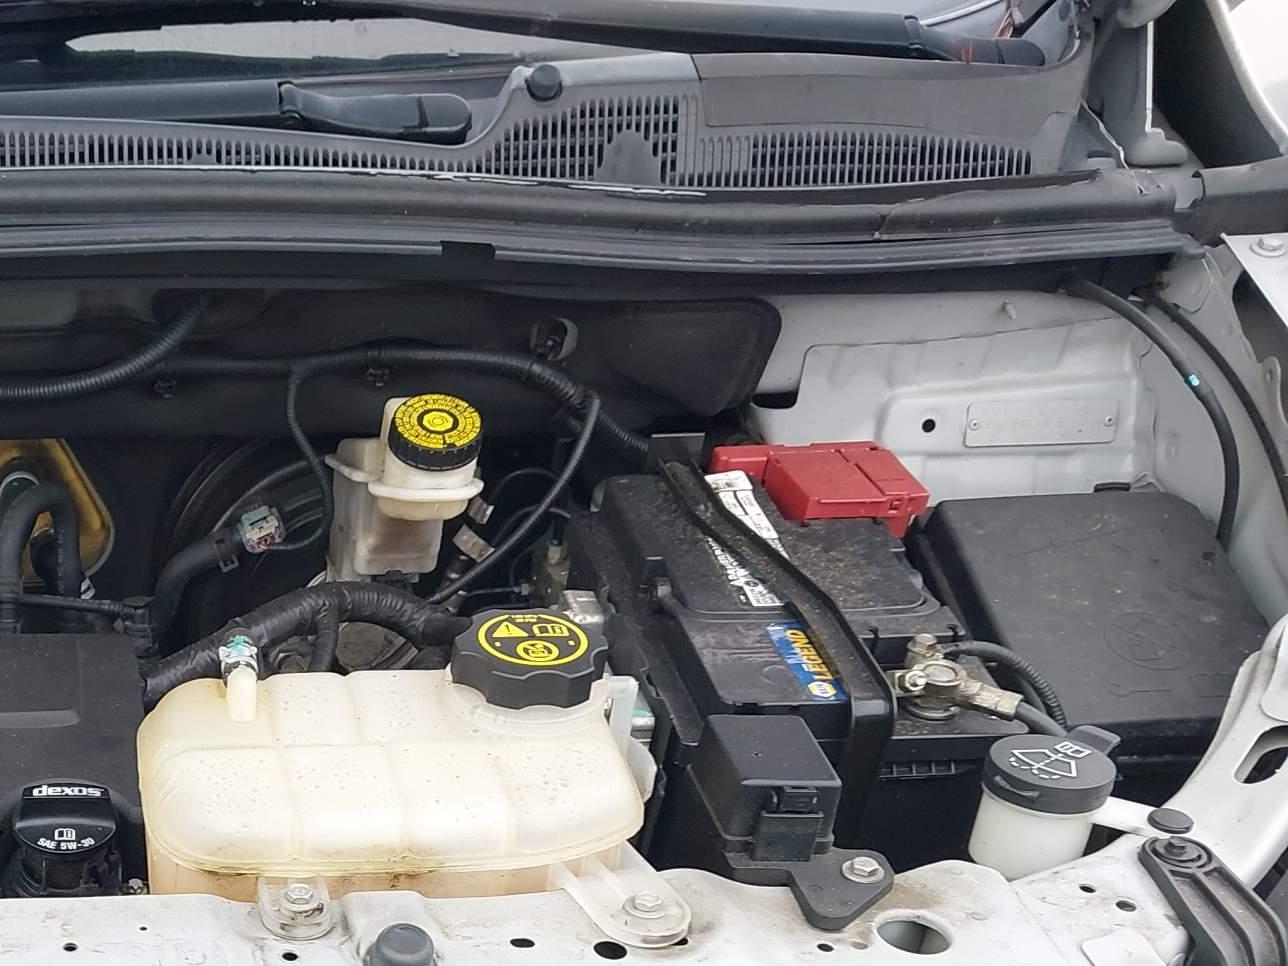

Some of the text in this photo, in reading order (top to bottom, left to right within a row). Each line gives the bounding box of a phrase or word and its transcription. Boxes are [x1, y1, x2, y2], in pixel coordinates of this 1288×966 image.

[785, 629, 833, 680] LEGEND
[32, 785, 105, 797] dexos
[37, 837, 96, 850] SAE 5W-30
